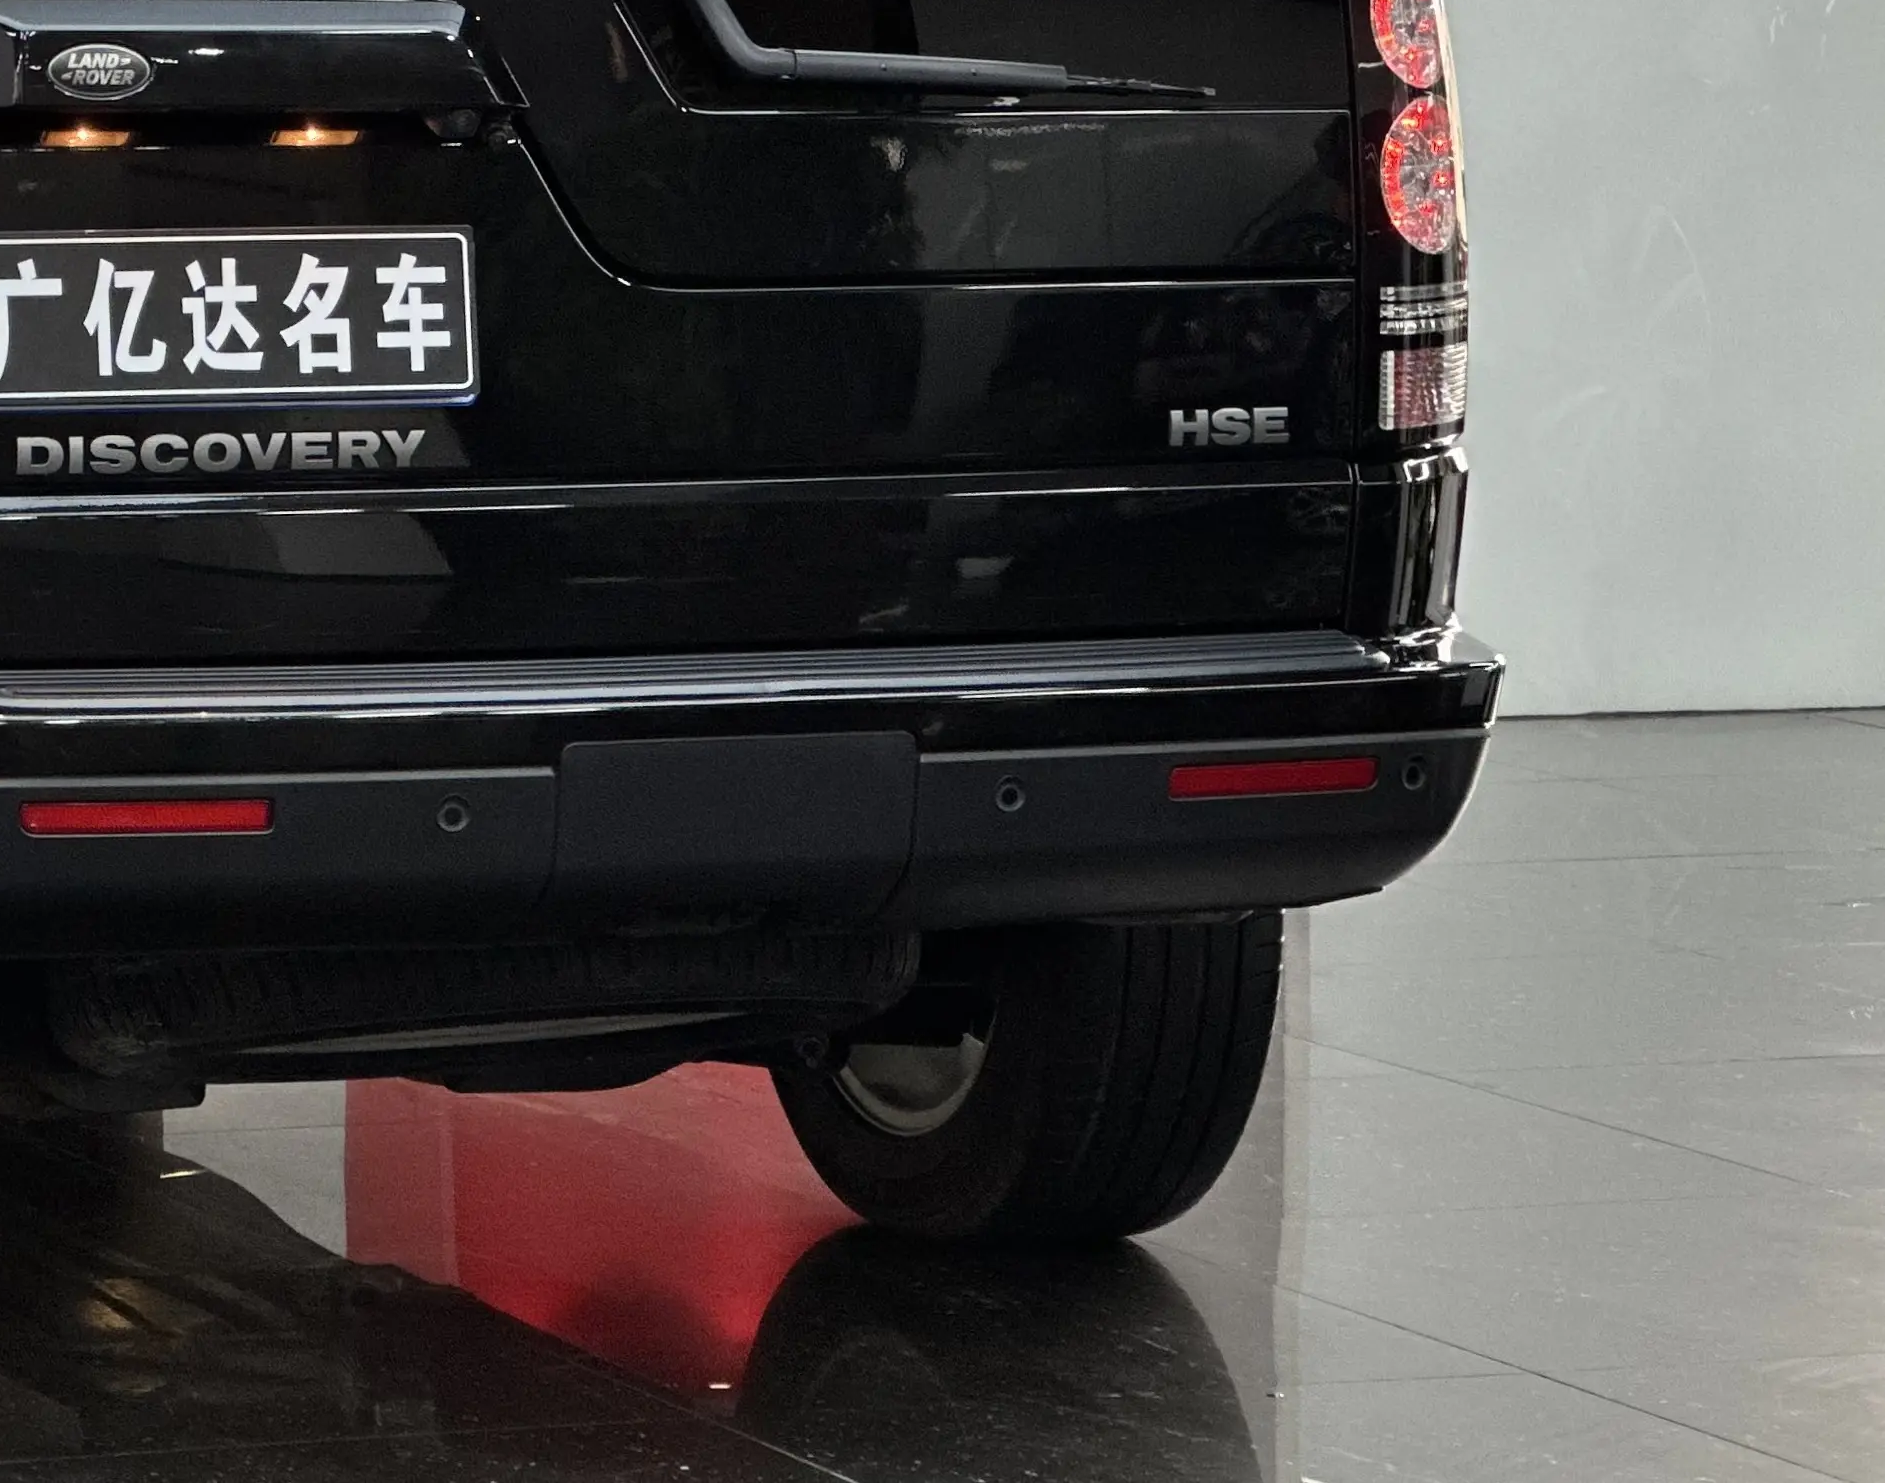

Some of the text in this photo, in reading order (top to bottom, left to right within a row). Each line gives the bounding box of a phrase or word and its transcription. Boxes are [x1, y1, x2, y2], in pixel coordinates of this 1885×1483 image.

[67, 52, 121, 69] LAND
[71, 69, 136, 86] ROVER
[1169, 406, 1290, 447] HSE
[15, 429, 426, 476] DISCOVERY
